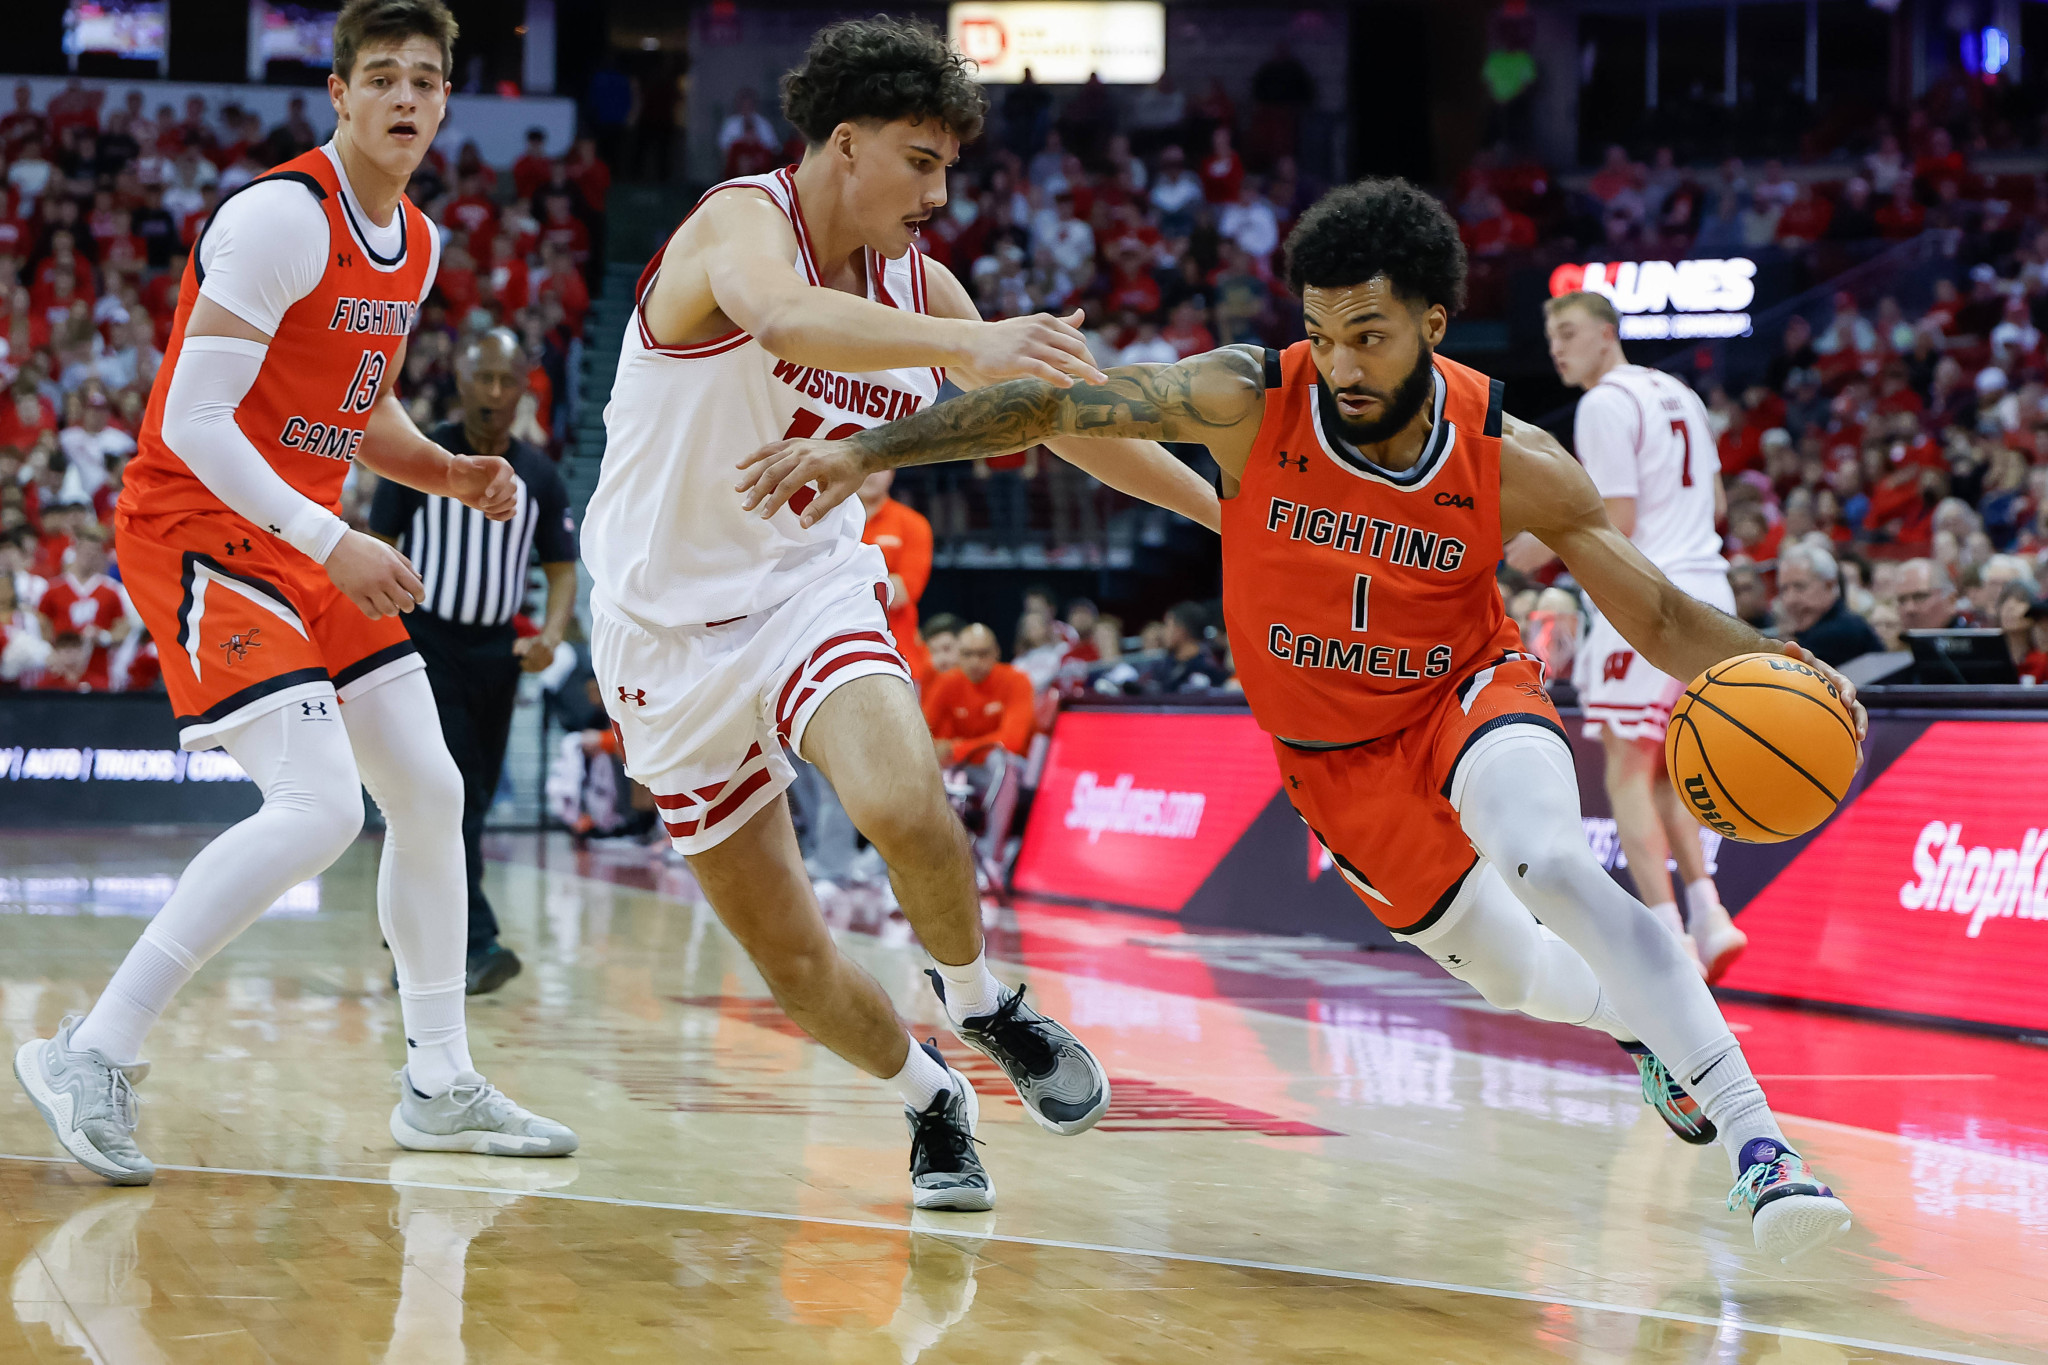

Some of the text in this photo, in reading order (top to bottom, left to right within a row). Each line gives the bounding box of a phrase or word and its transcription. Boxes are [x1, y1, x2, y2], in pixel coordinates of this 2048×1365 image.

[338, 349, 387, 413] 13
[772, 358, 922, 421] WISCONSIN
[278, 415, 365, 462] CAME
[1670, 420, 1694, 488] 7
[1434, 492, 1475, 510] CAA
[1266, 496, 1467, 573] FIGHTING
[1351, 573, 1372, 632] 1
[1268, 623, 1452, 679] CAMELS
